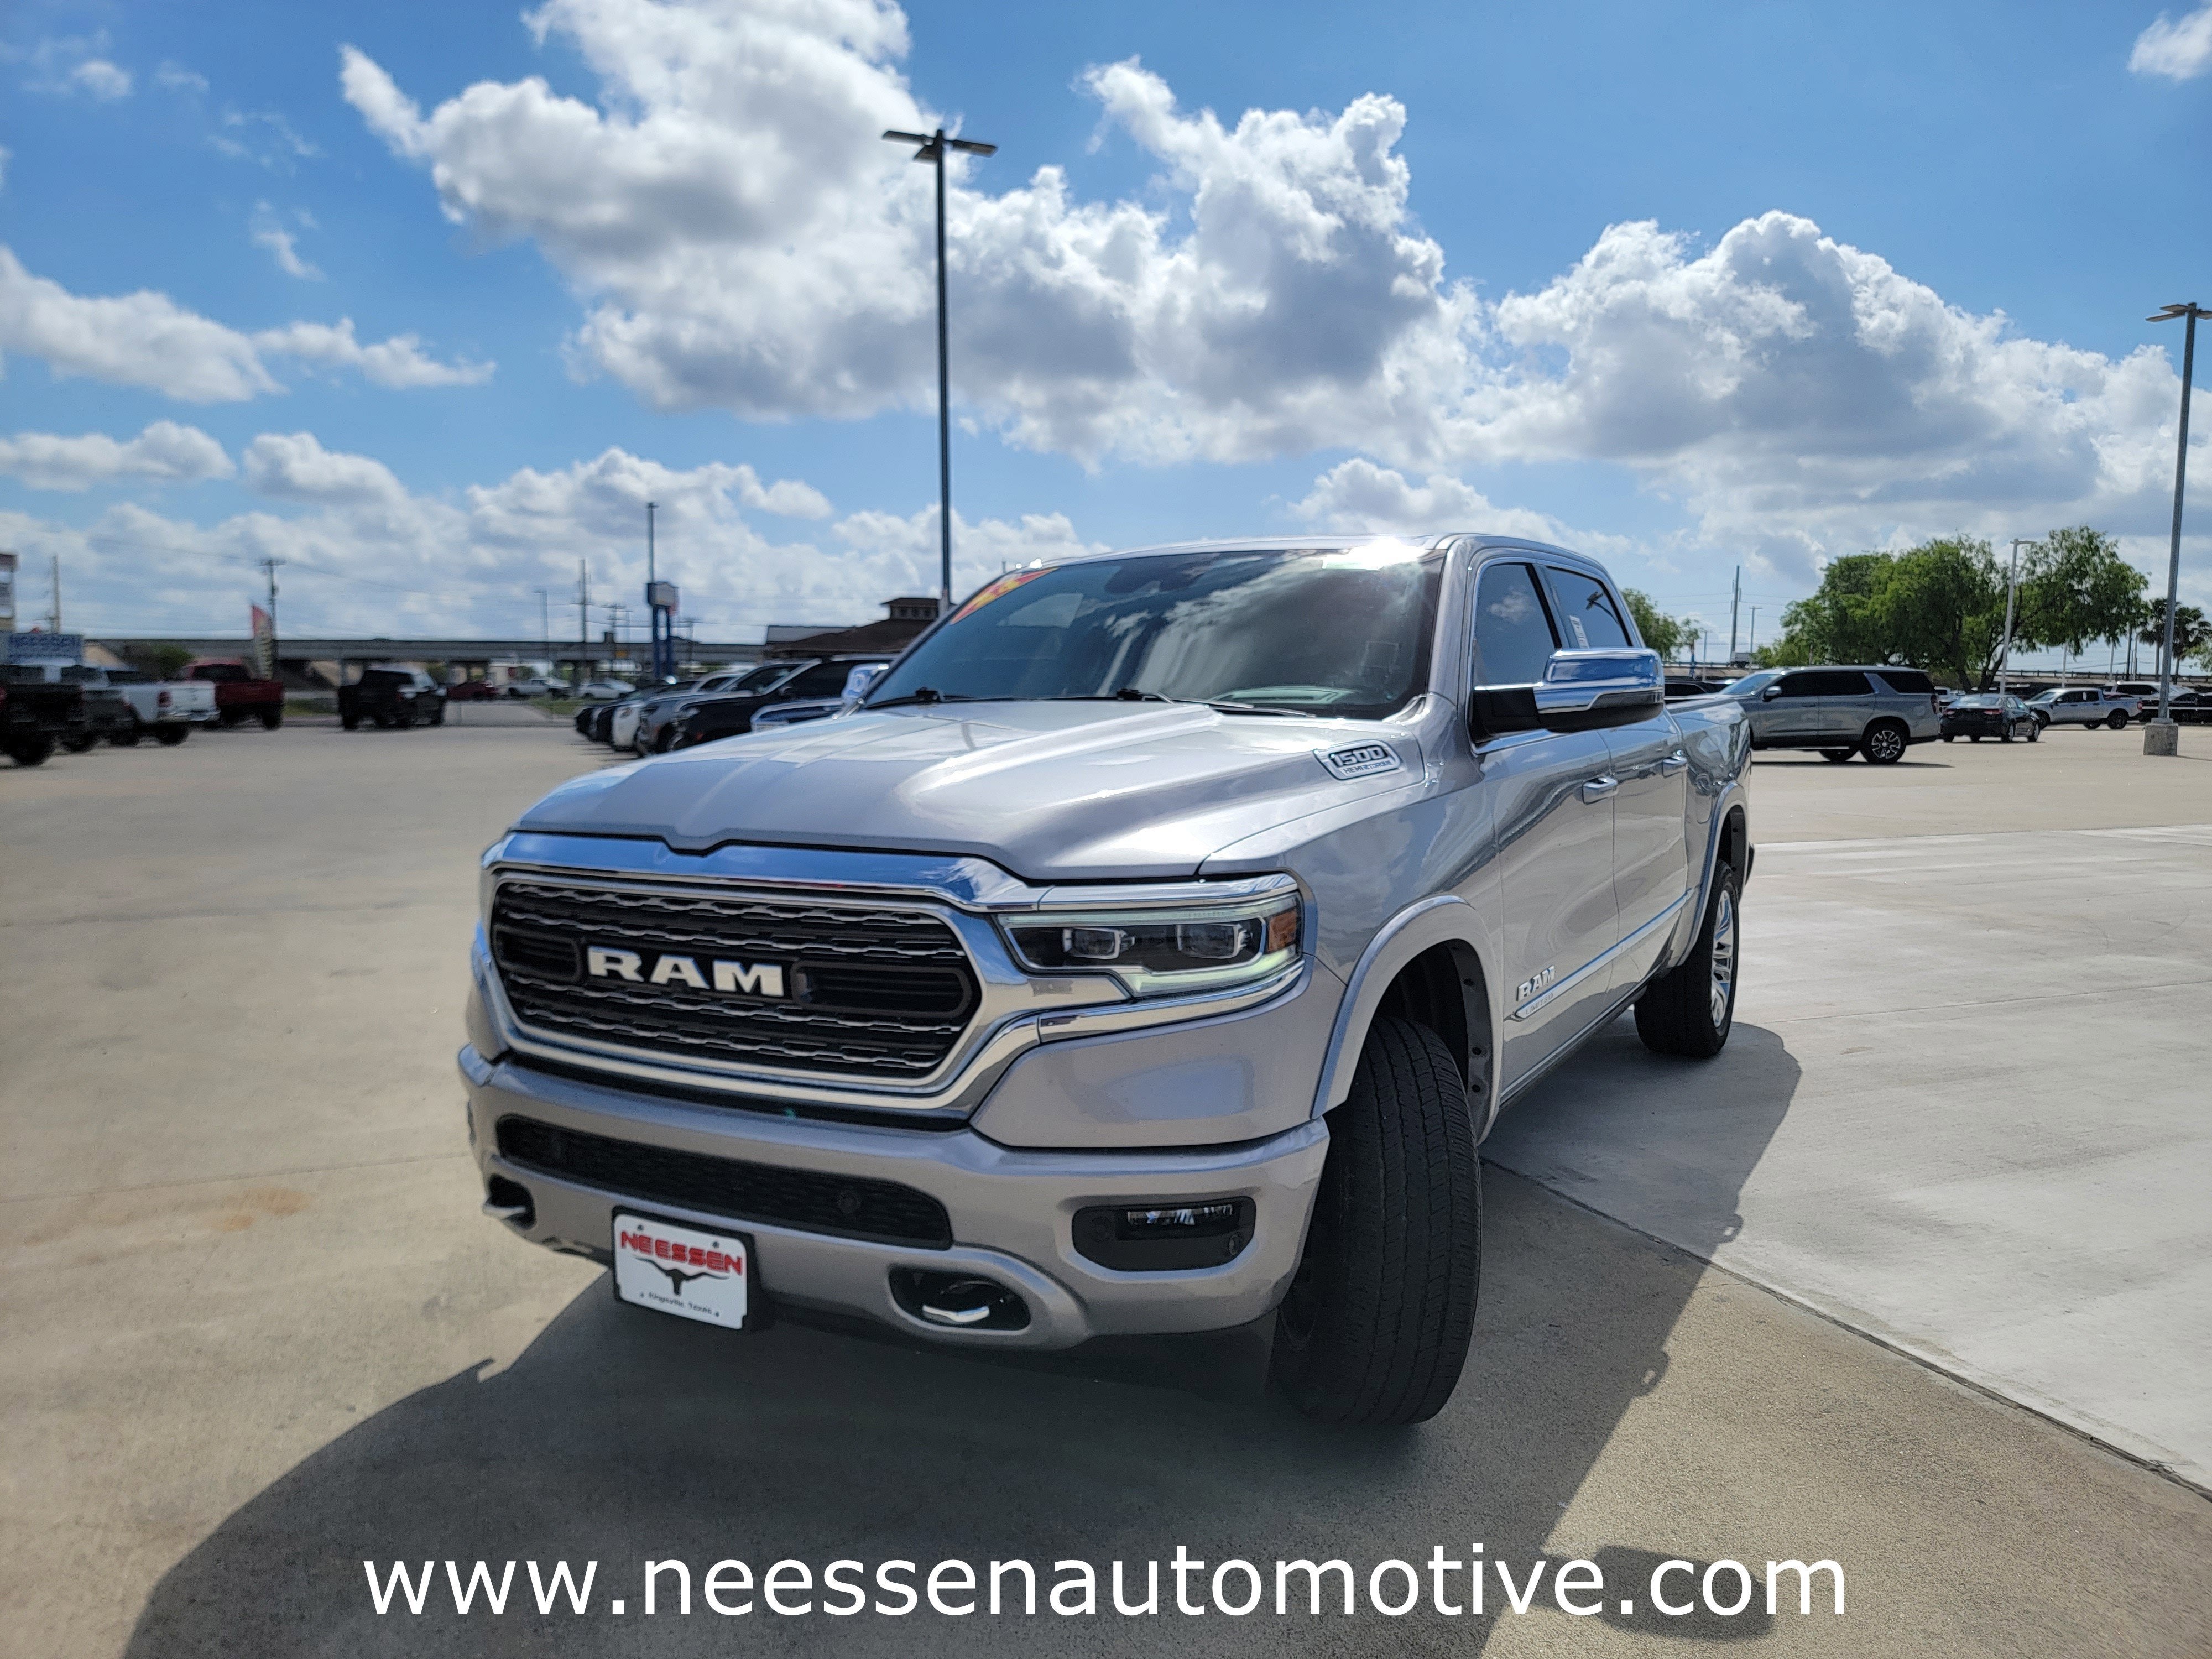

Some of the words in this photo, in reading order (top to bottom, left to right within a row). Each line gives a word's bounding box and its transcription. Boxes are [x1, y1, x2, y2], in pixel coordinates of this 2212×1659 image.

[1331, 747, 1385, 765] 1500
[1343, 765, 1364, 774] HEMI
[587, 945, 784, 995] RAM
[1516, 966, 1554, 1001] RAM
[620, 1230, 742, 1275] NEESSEN
